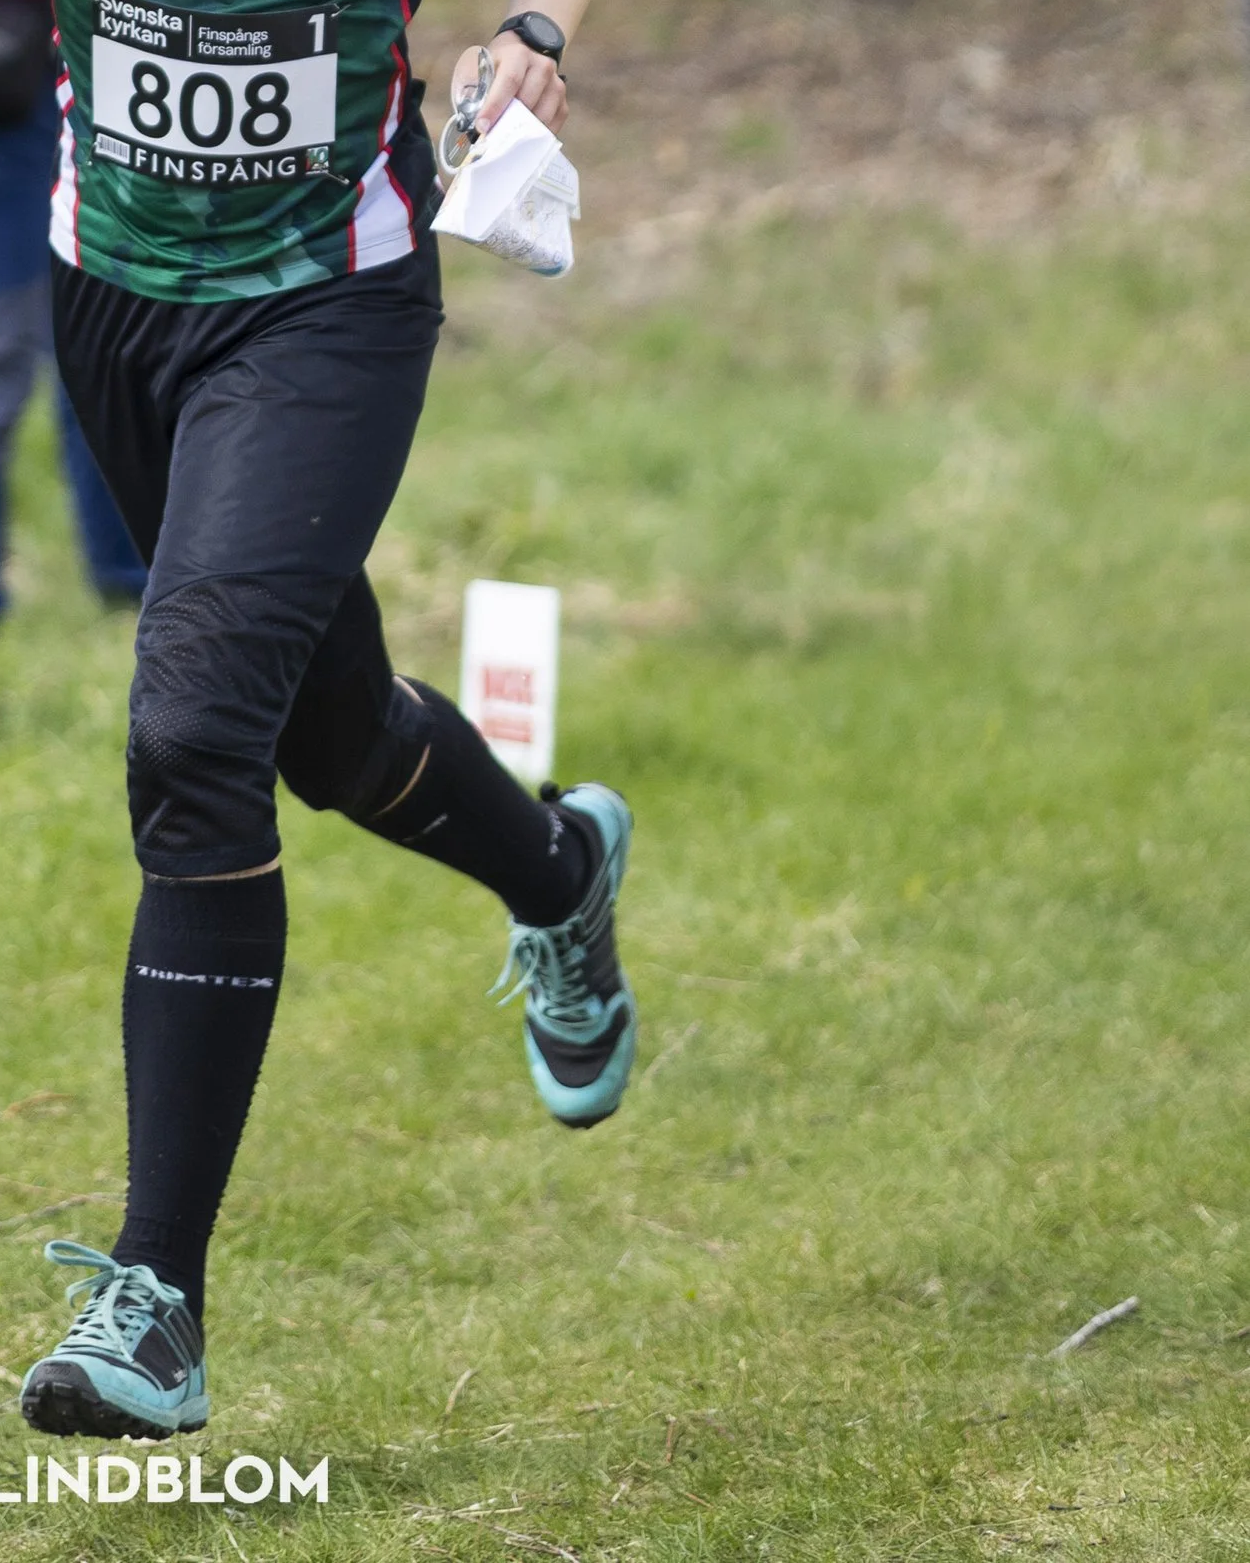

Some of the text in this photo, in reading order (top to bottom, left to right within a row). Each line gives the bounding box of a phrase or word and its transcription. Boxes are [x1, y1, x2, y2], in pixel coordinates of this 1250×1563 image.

[100, 10, 167, 47] kyrkan
[198, 26, 269, 45] Finspångs
[308, 13, 325, 53] 1
[198, 41, 272, 58] församling
[128, 60, 292, 148] 808
[135, 148, 296, 182] FINSPÅNG
